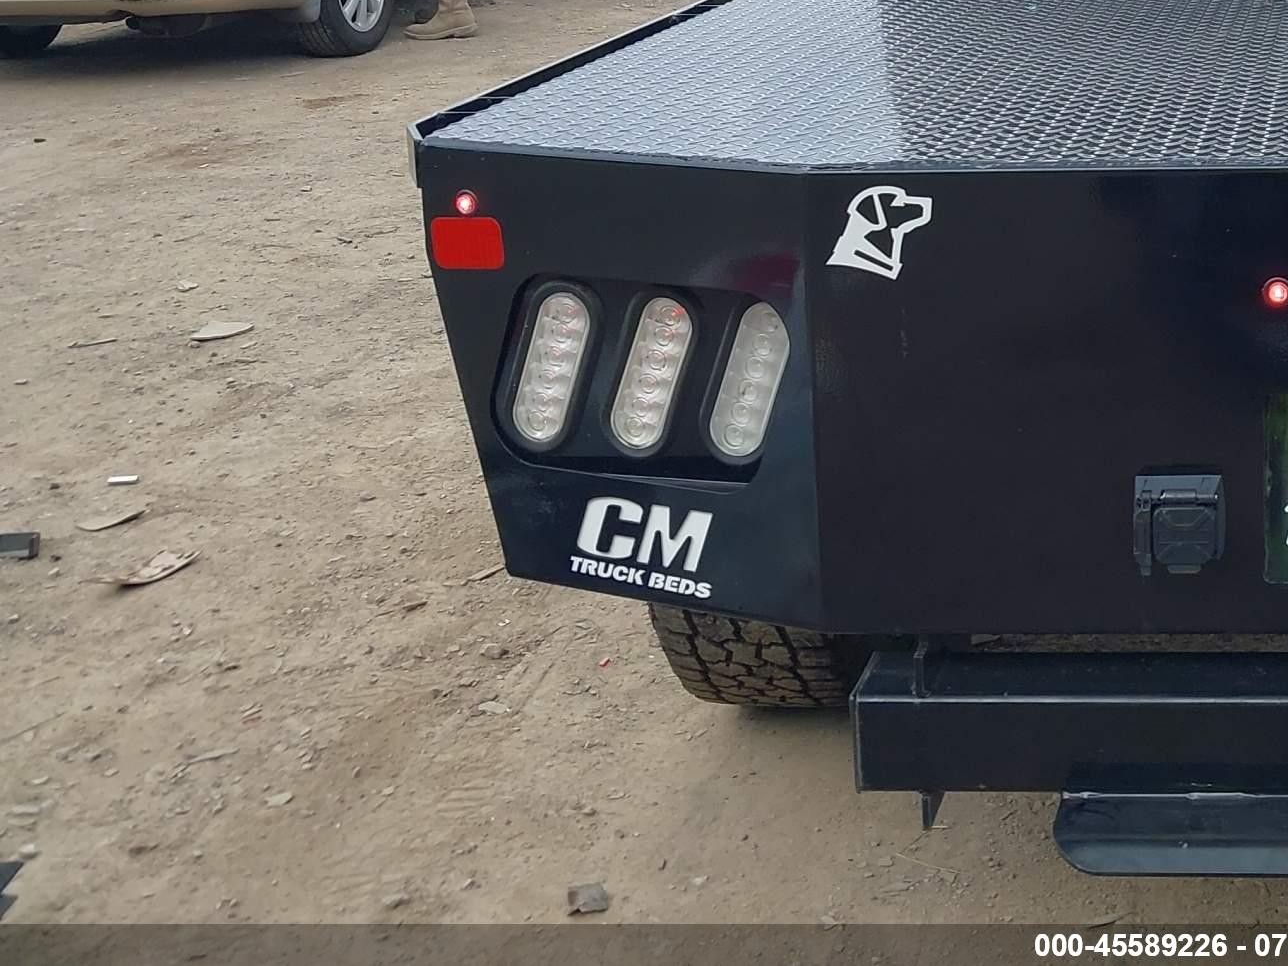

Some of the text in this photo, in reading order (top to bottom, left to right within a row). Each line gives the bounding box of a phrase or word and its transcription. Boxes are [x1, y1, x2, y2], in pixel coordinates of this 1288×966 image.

[577, 496, 713, 572] CM
[570, 555, 713, 599] TRUCK BEDS
